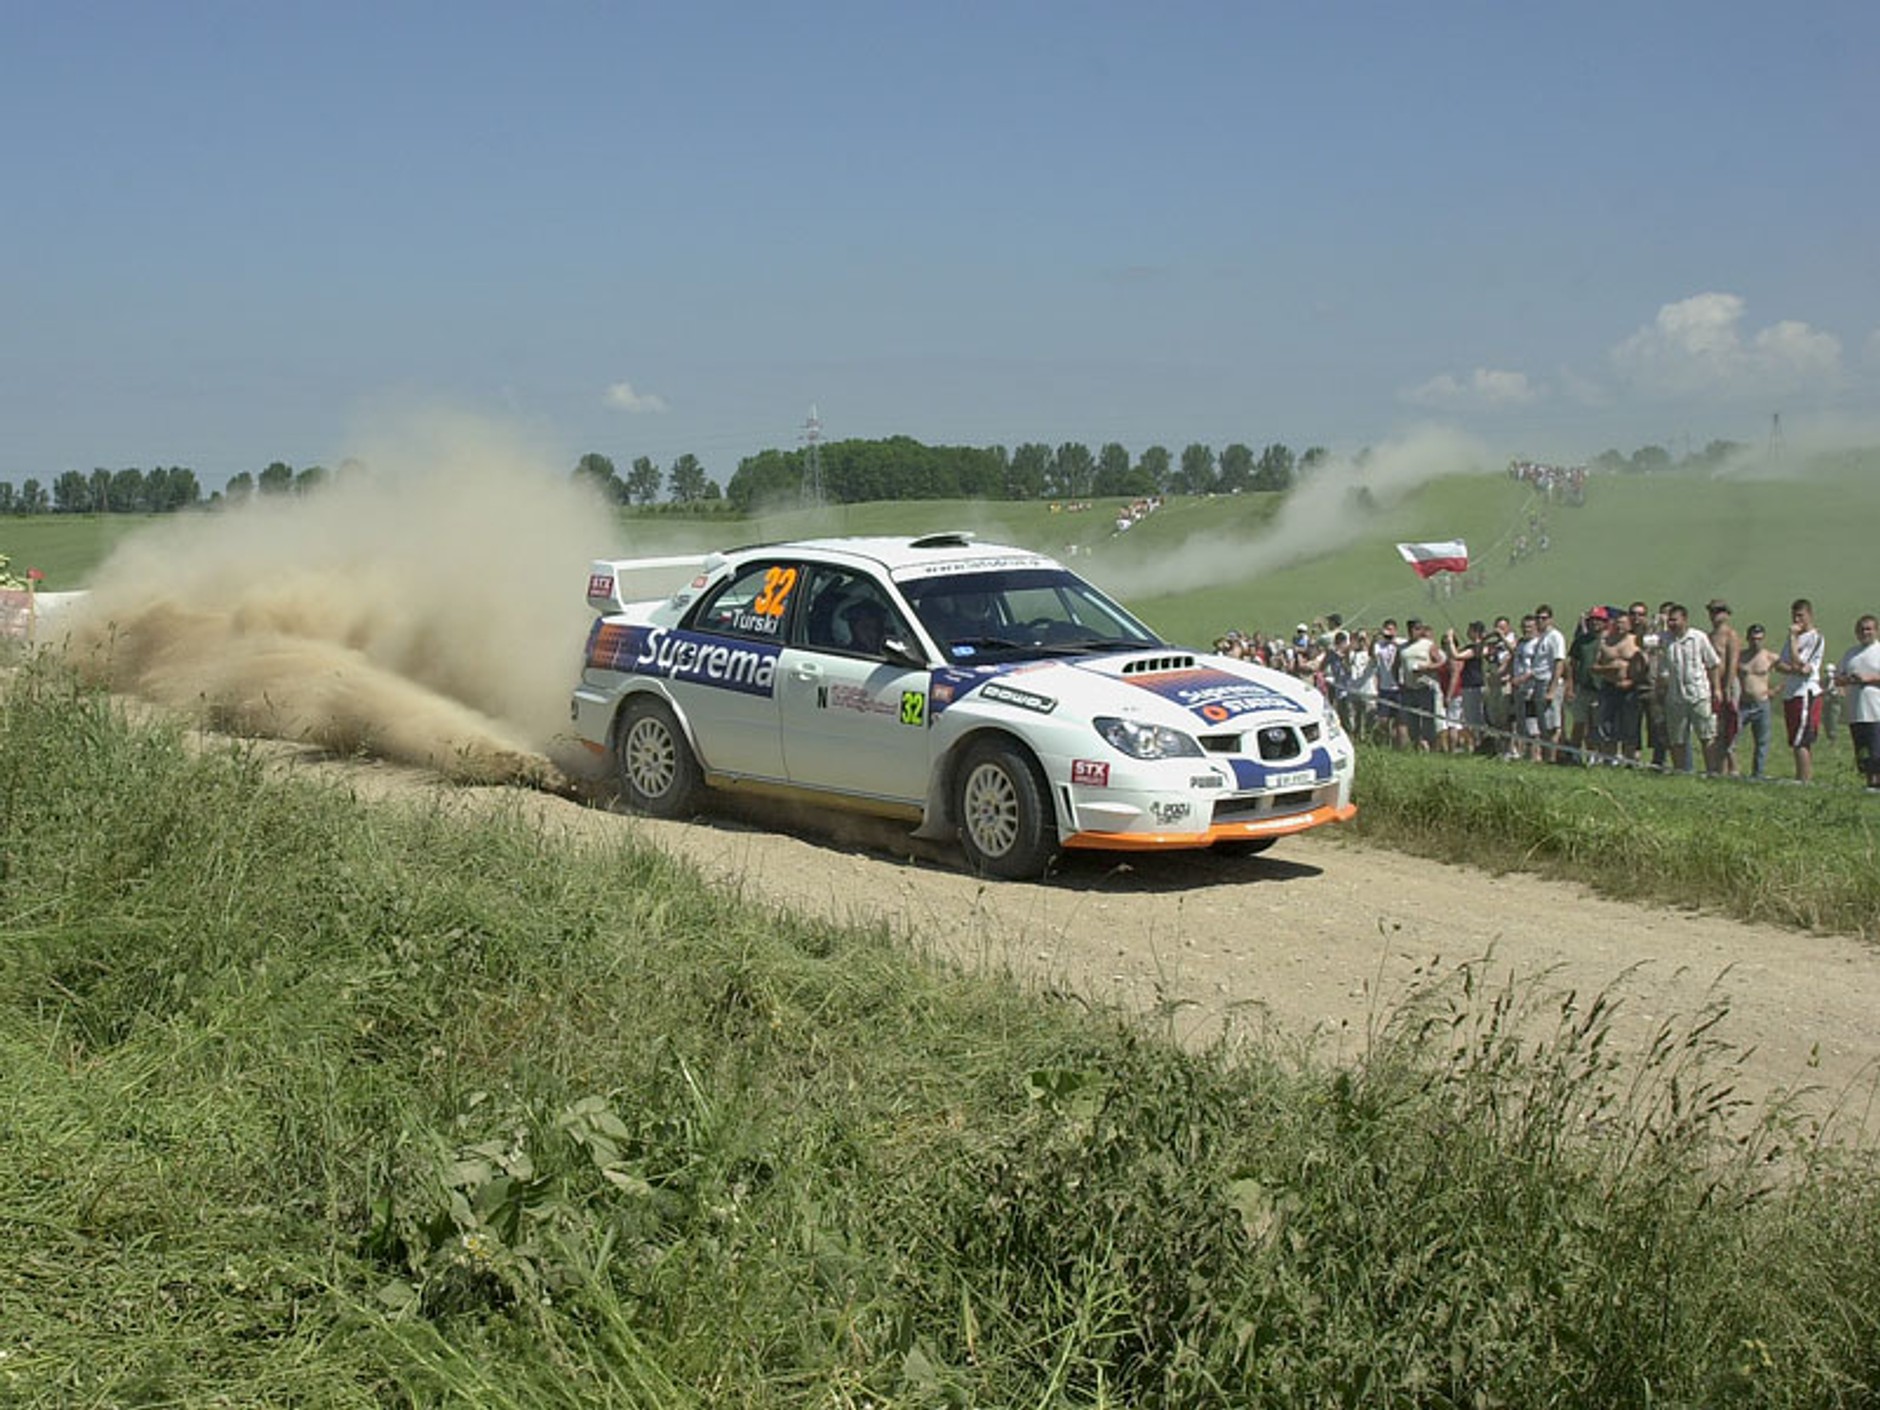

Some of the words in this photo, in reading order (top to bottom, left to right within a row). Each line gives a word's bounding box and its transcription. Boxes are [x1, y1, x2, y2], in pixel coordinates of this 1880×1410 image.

[754, 566, 797, 617] 32
[733, 608, 779, 634] Turski
[637, 627, 777, 688] Suprema
[817, 686, 828, 709] N
[902, 692, 923, 725] 32
[1075, 761, 1106, 776] STX
